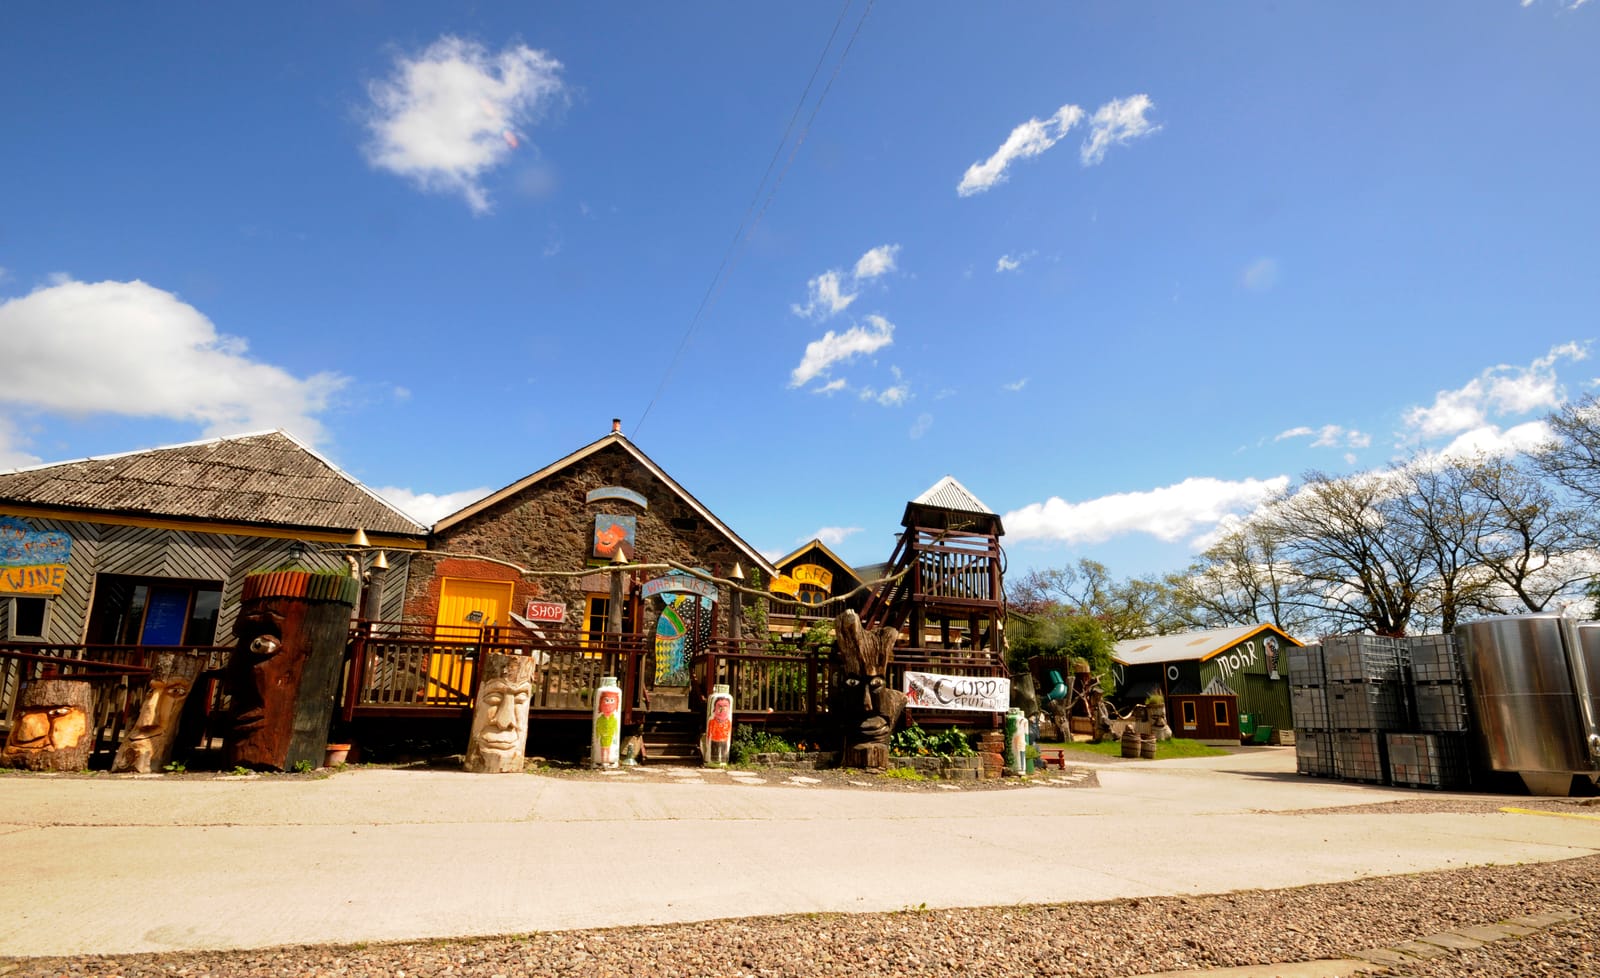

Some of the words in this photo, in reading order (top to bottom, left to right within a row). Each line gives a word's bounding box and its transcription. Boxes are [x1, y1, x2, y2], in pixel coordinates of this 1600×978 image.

[7, 567, 64, 590] WINE
[795, 565, 830, 585] CAFE
[647, 576, 676, 593] WHAT
[531, 605, 562, 618] SHOP
